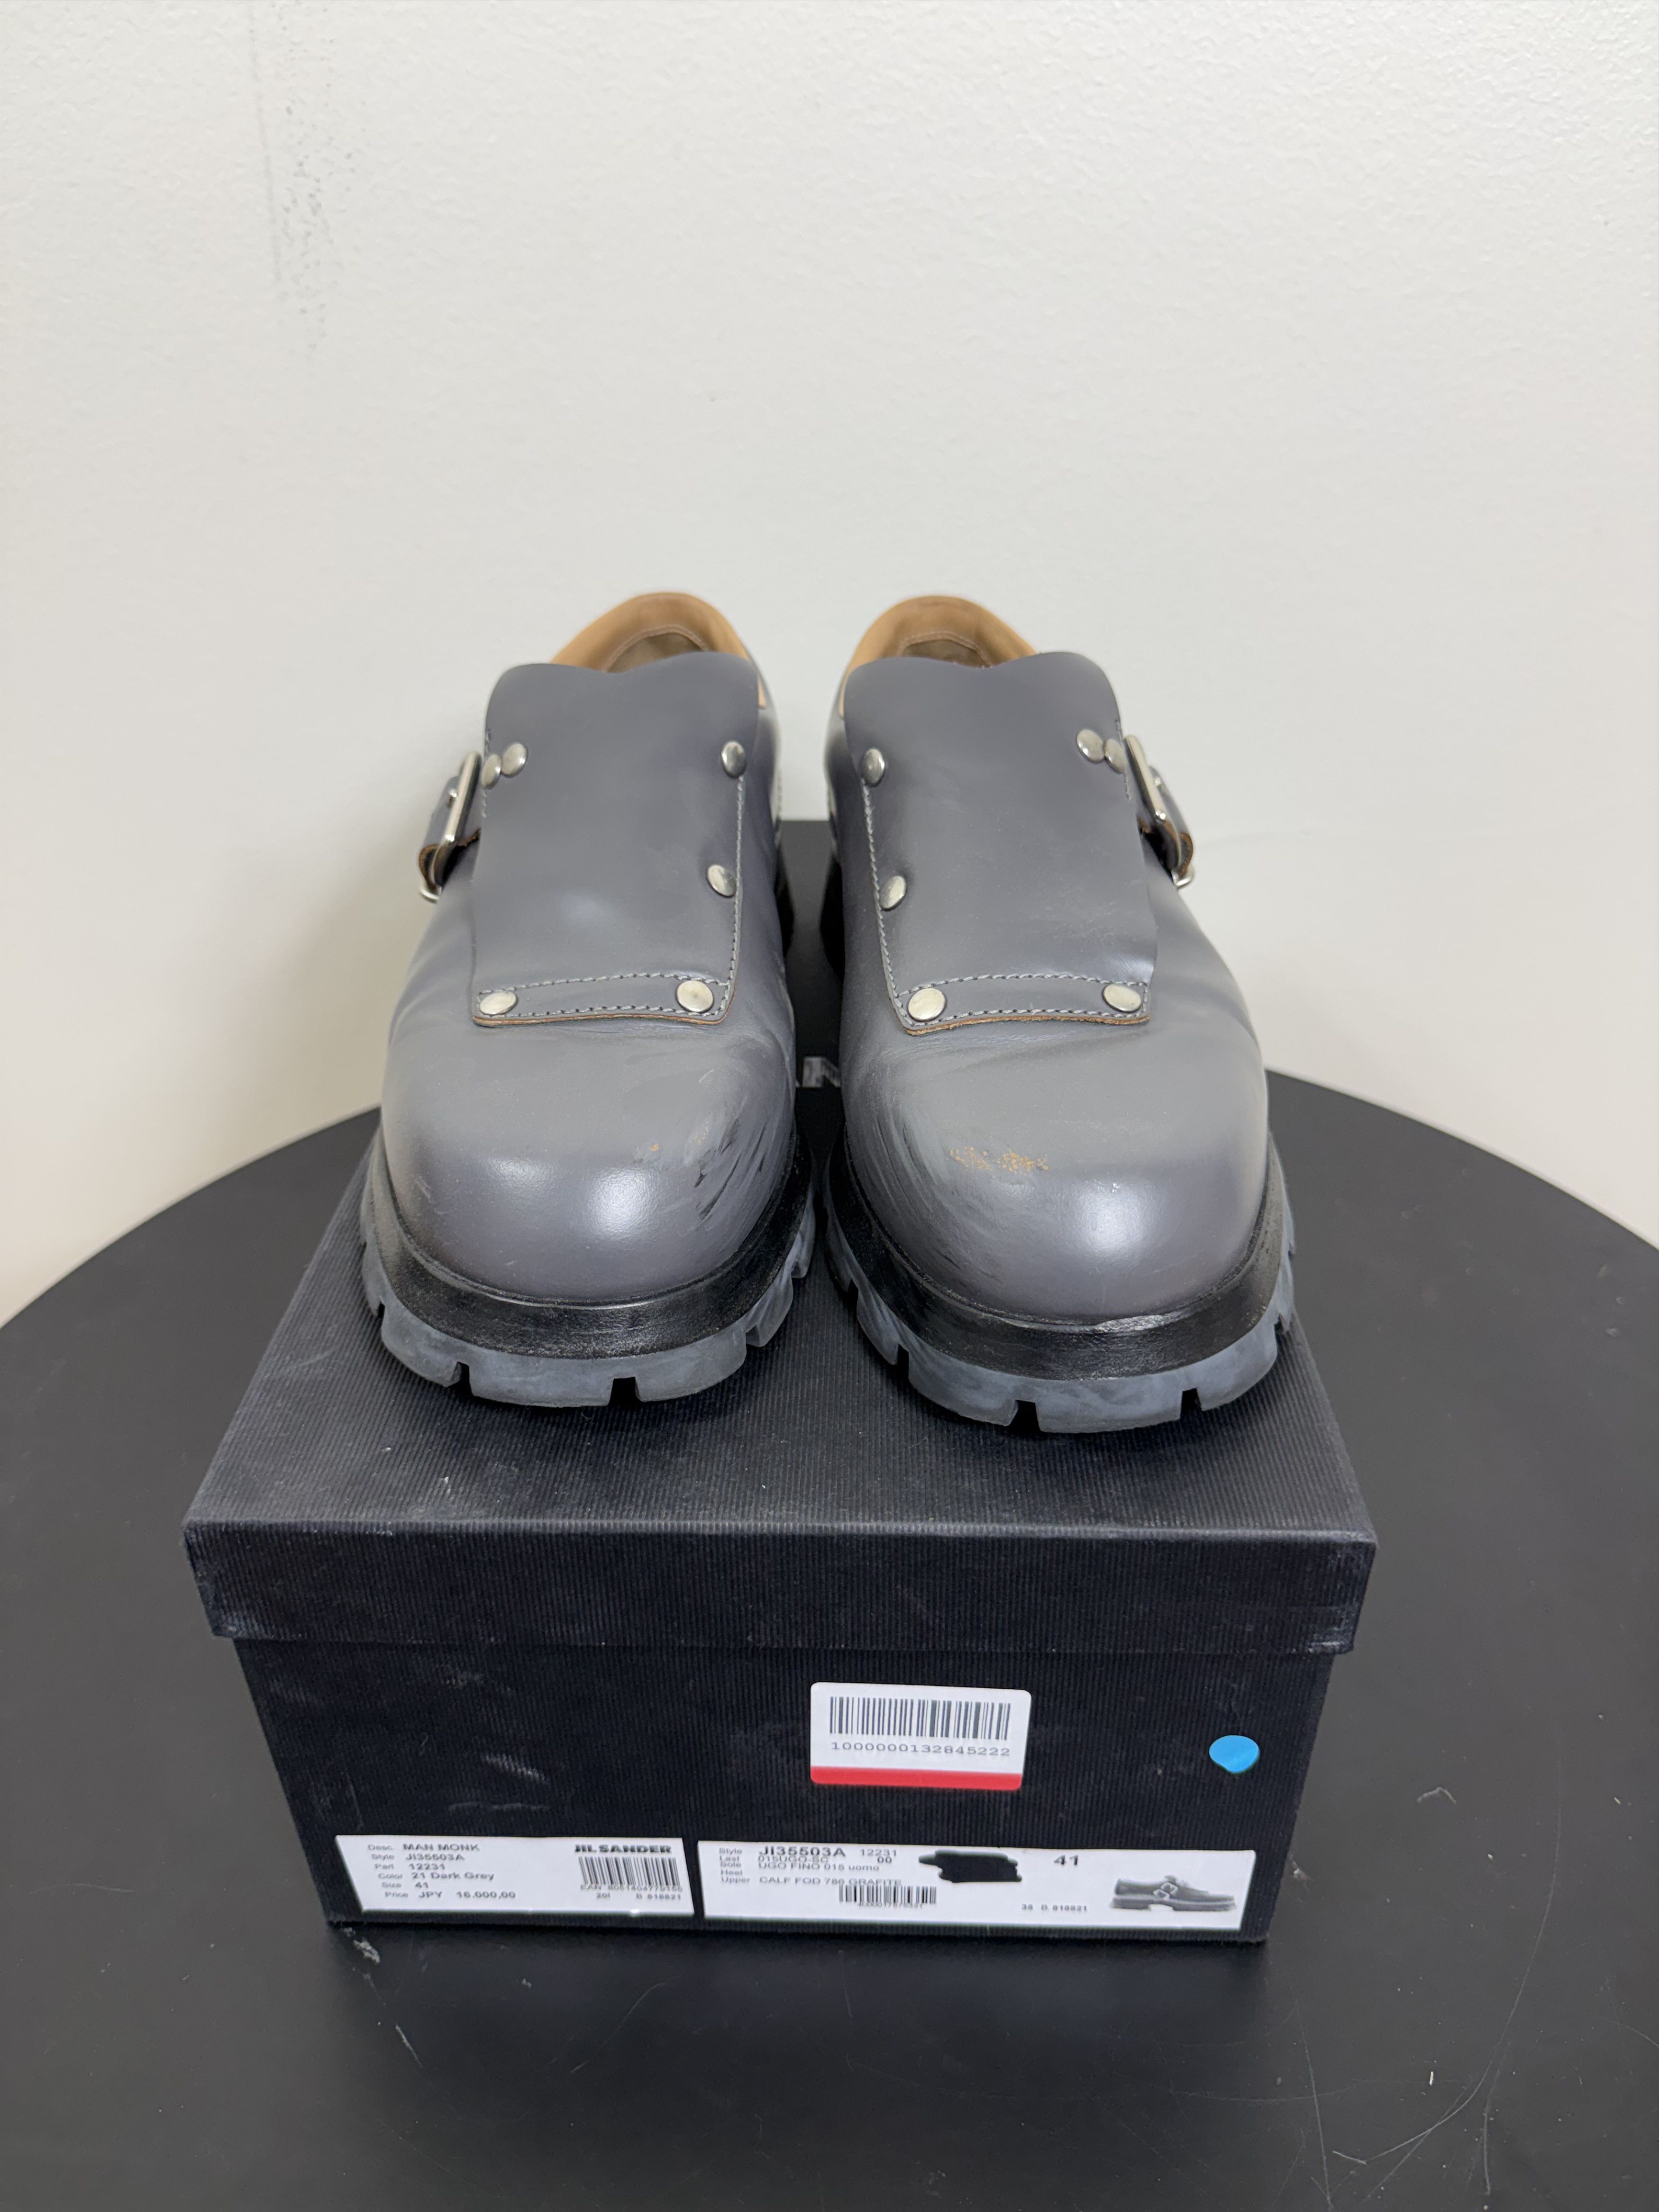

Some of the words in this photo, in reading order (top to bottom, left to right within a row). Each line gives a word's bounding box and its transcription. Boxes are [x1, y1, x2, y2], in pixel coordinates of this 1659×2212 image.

[831, 1742, 1010, 1756] 1000000132845222
[575, 1844, 597, 1853] JIL
[599, 1845, 672, 1853] SANDER
[759, 1846, 846, 1857] JI35503A
[860, 1849, 897, 1857] 12231
[1054, 1854, 1079, 1866] 41
[791, 1862, 820, 1870] FINO
[465, 1873, 494, 1881] Grey
